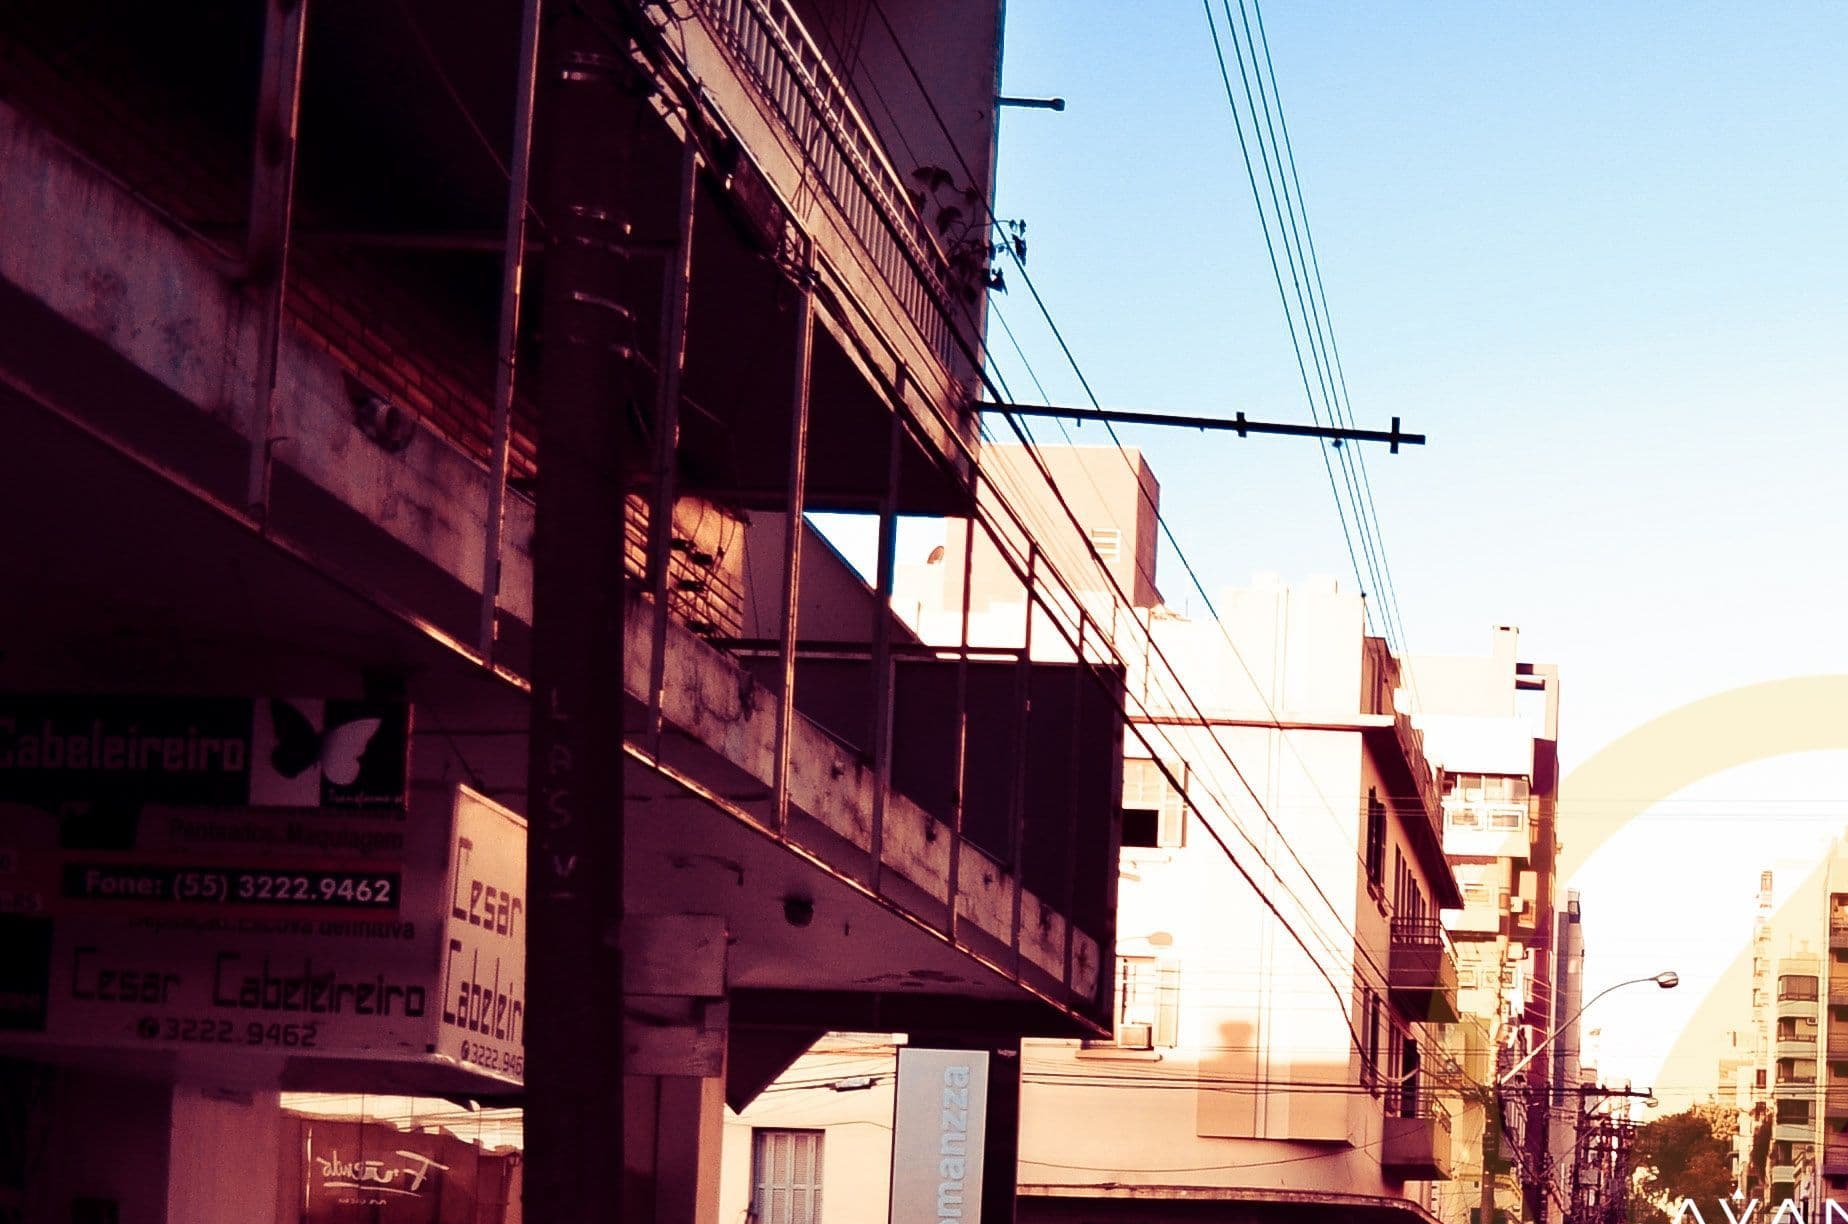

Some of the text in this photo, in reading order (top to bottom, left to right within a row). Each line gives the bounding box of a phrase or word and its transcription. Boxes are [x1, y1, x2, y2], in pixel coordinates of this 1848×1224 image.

[85, 868, 392, 904] Fone: (55) 3222.9462
[453, 836, 523, 938] Cesar
[72, 945, 426, 1018] Cesar Cabeleireiro
[165, 1017, 318, 1047] 3222.9462
